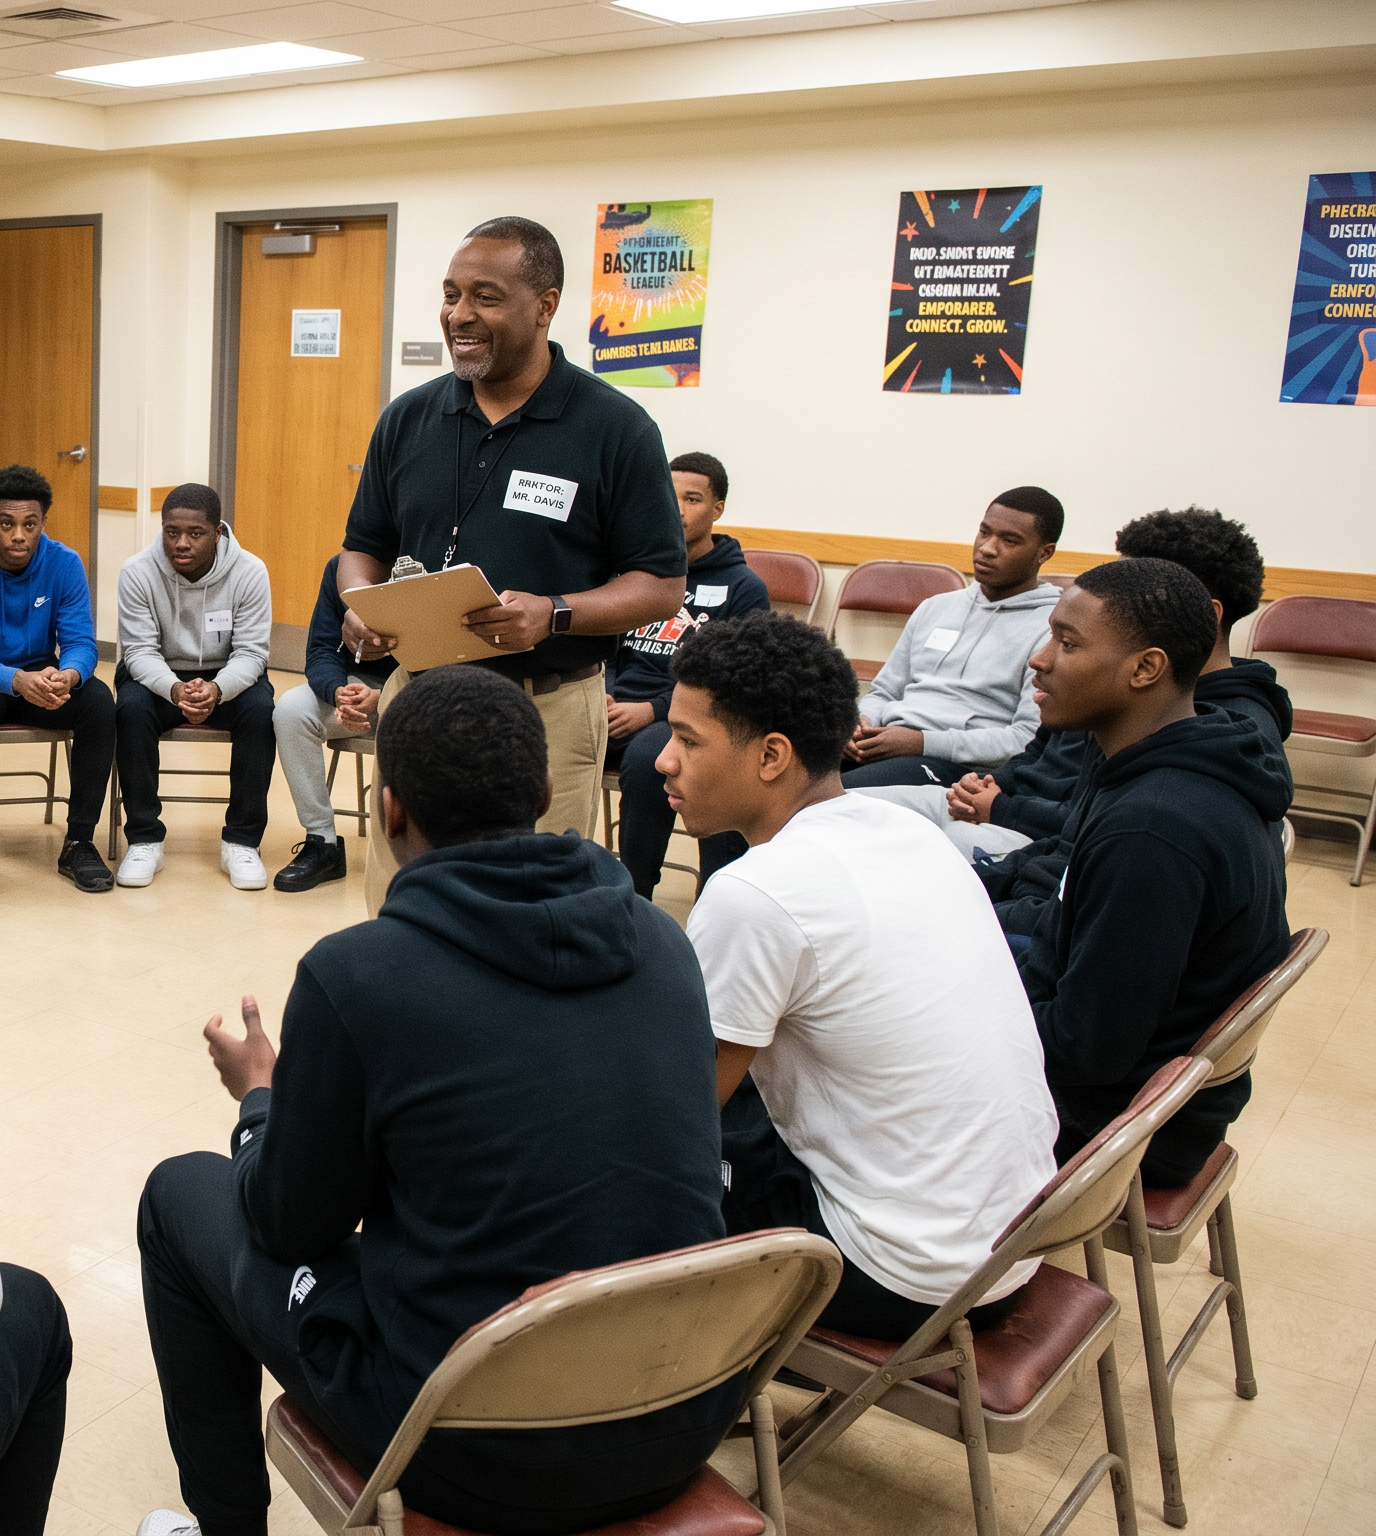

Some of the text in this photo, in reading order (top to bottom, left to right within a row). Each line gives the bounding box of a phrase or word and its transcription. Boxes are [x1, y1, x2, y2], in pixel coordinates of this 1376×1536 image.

[603, 249, 695, 274] BASKETBALL
[905, 319, 1008, 334] CONNECT. GROW.
[512, 491, 565, 510] MR. DAVIS
